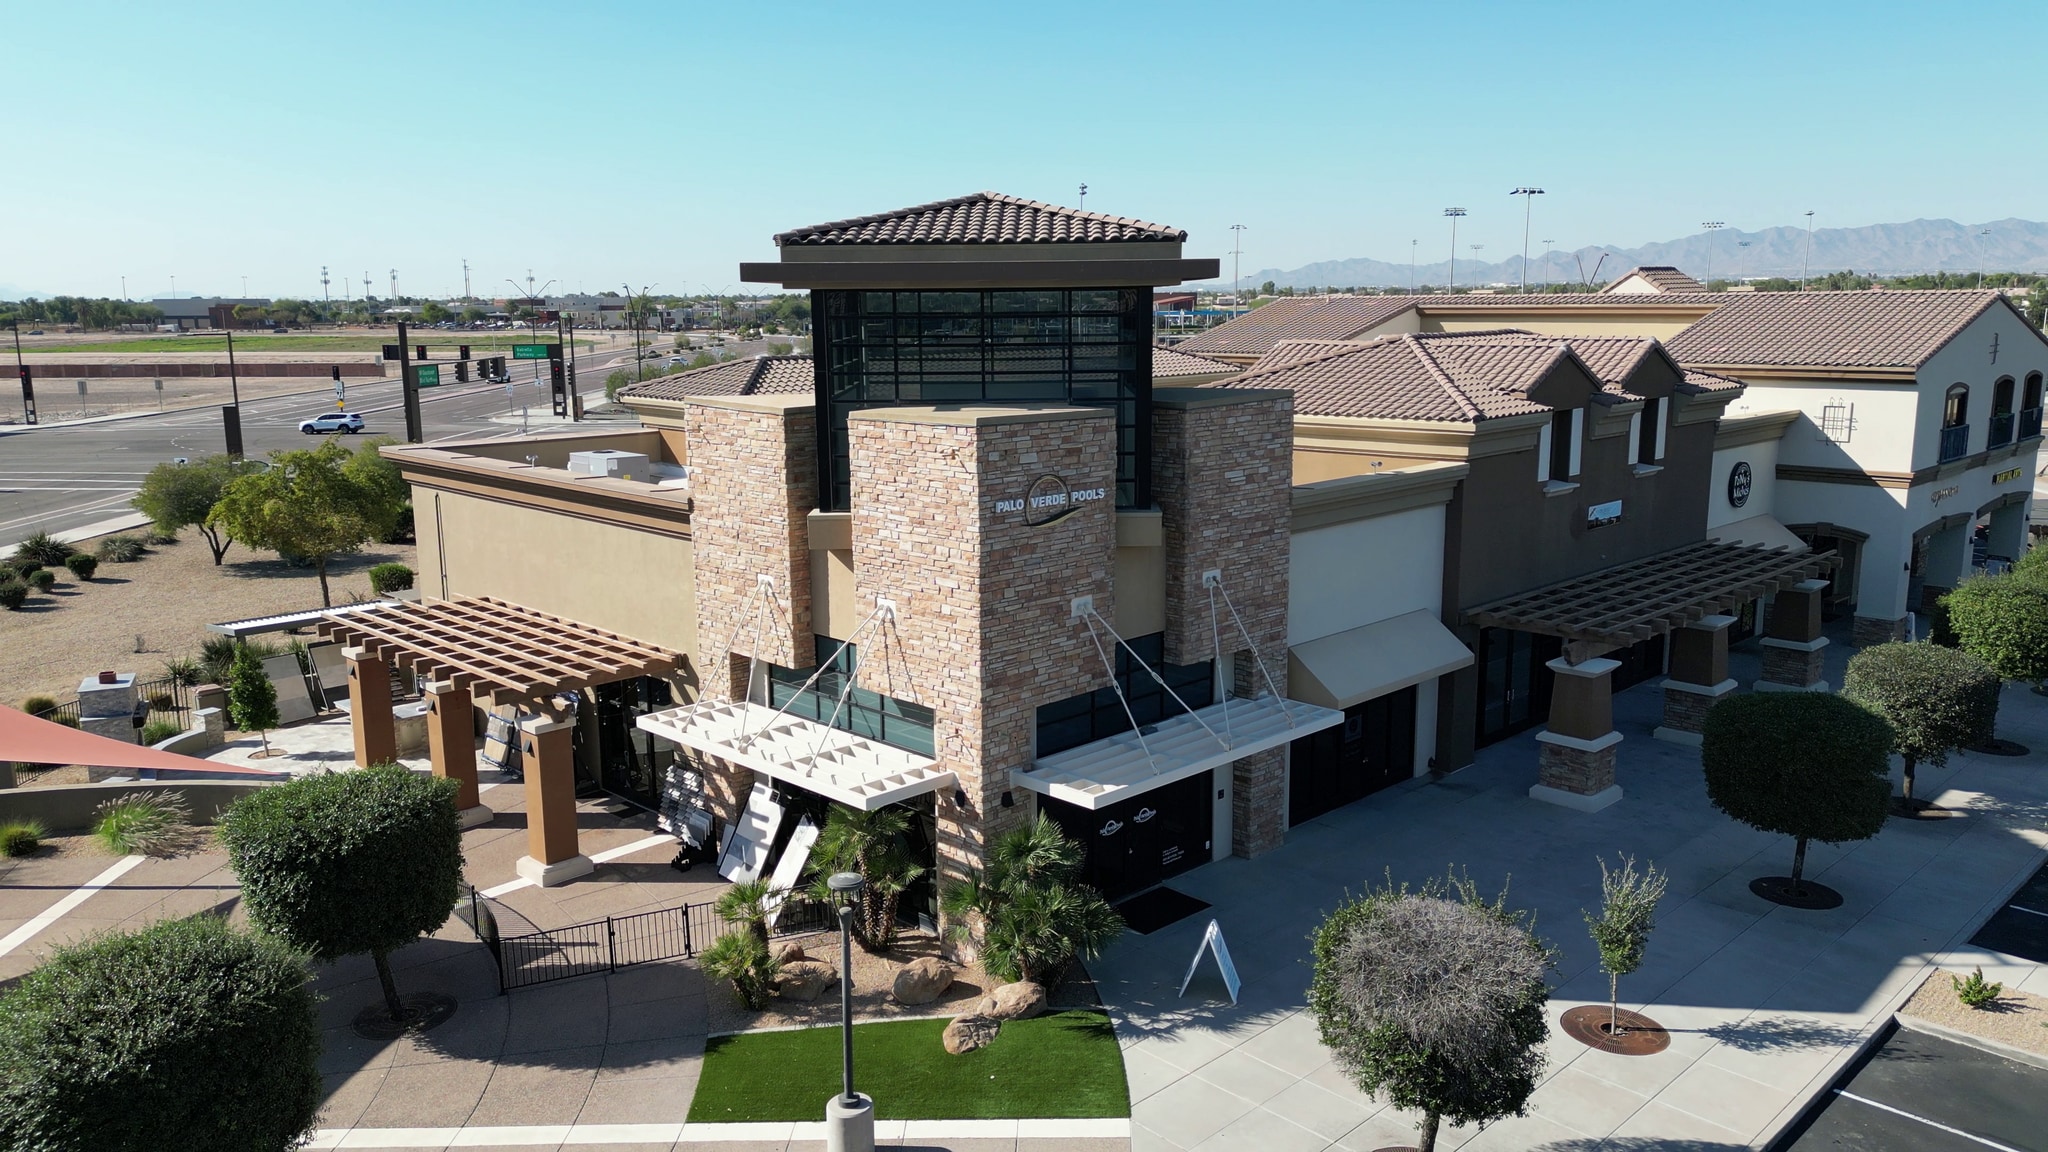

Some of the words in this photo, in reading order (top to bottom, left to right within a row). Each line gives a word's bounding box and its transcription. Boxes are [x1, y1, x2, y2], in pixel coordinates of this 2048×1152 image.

[995, 498, 1025, 514] PALO
[1030, 492, 1066, 509] VERDE
[1070, 487, 1105, 503] POOLS
